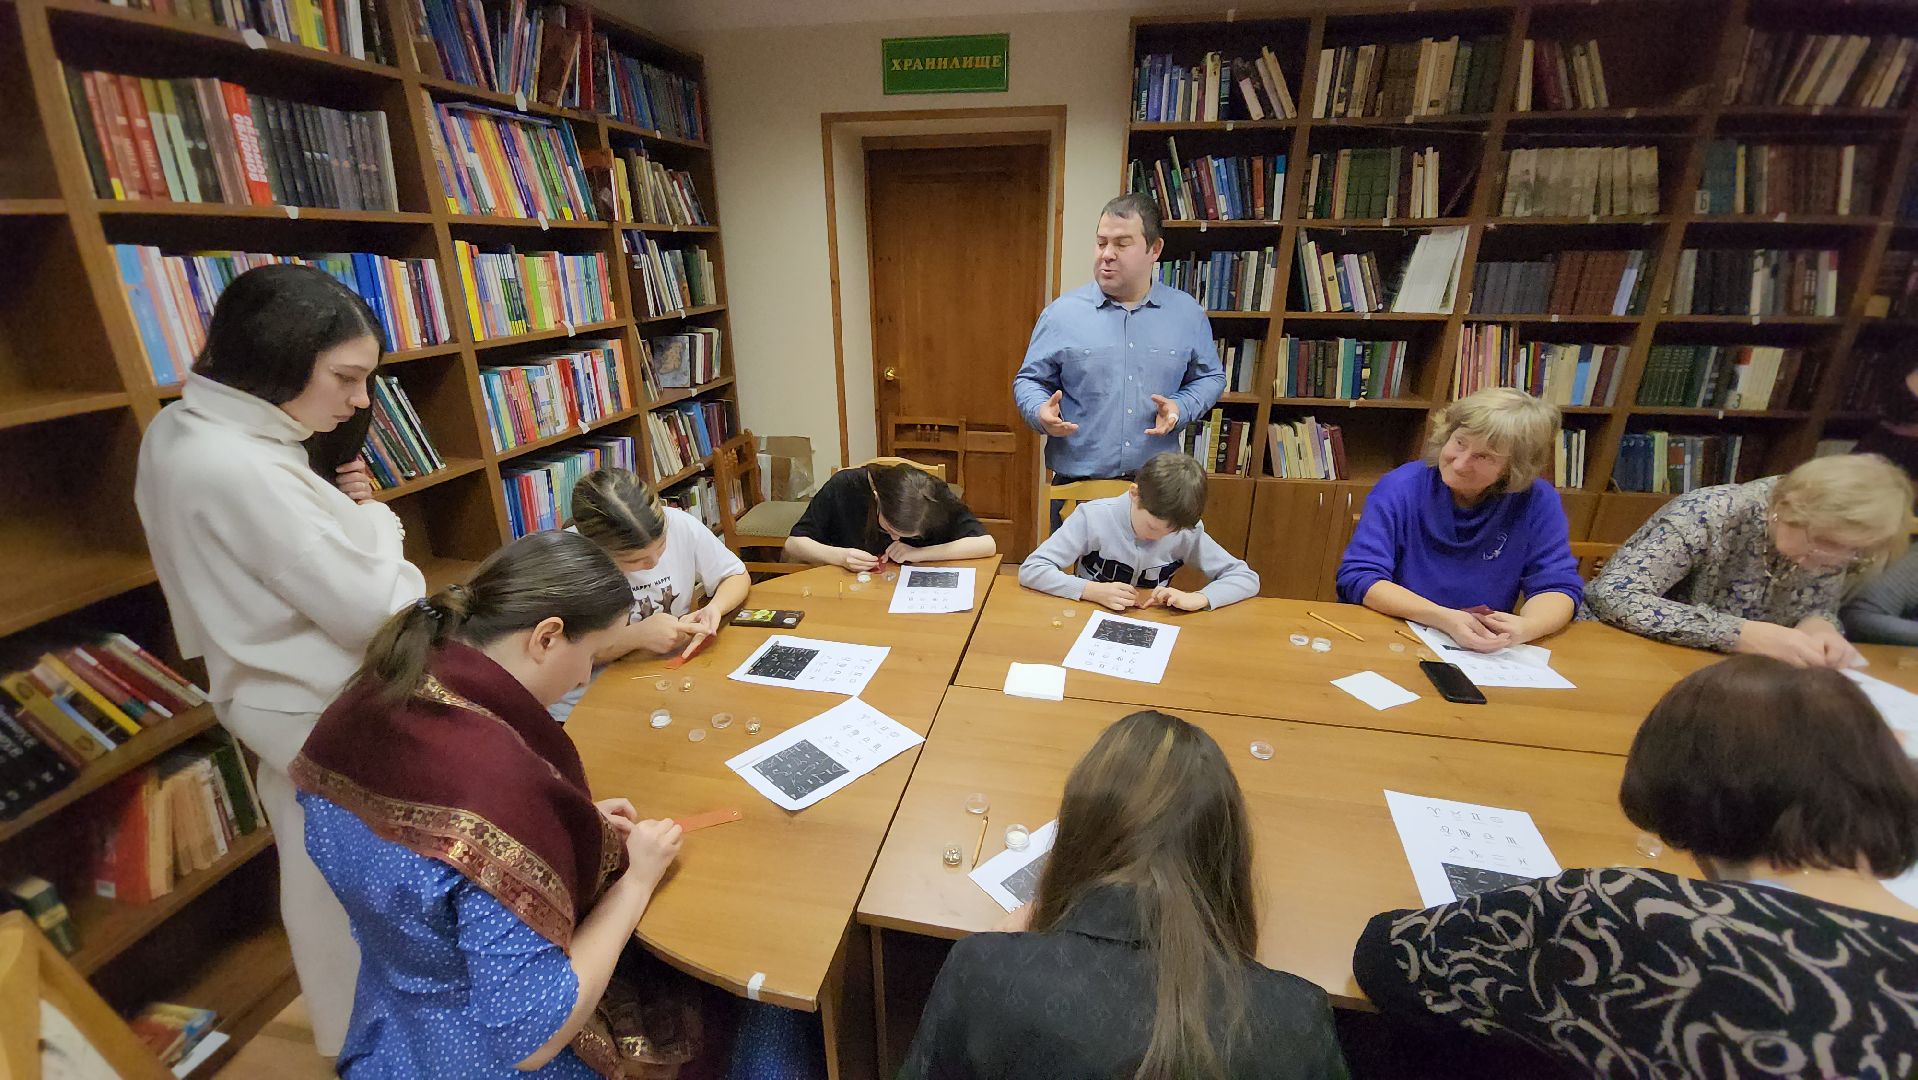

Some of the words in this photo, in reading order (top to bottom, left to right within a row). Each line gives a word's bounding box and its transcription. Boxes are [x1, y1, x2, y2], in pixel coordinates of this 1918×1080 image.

[890, 54, 1002, 71] ХРАНИЛИЩЕ
[632, 583, 651, 591] HAPPY
[654, 576, 670, 585] HAPPY
